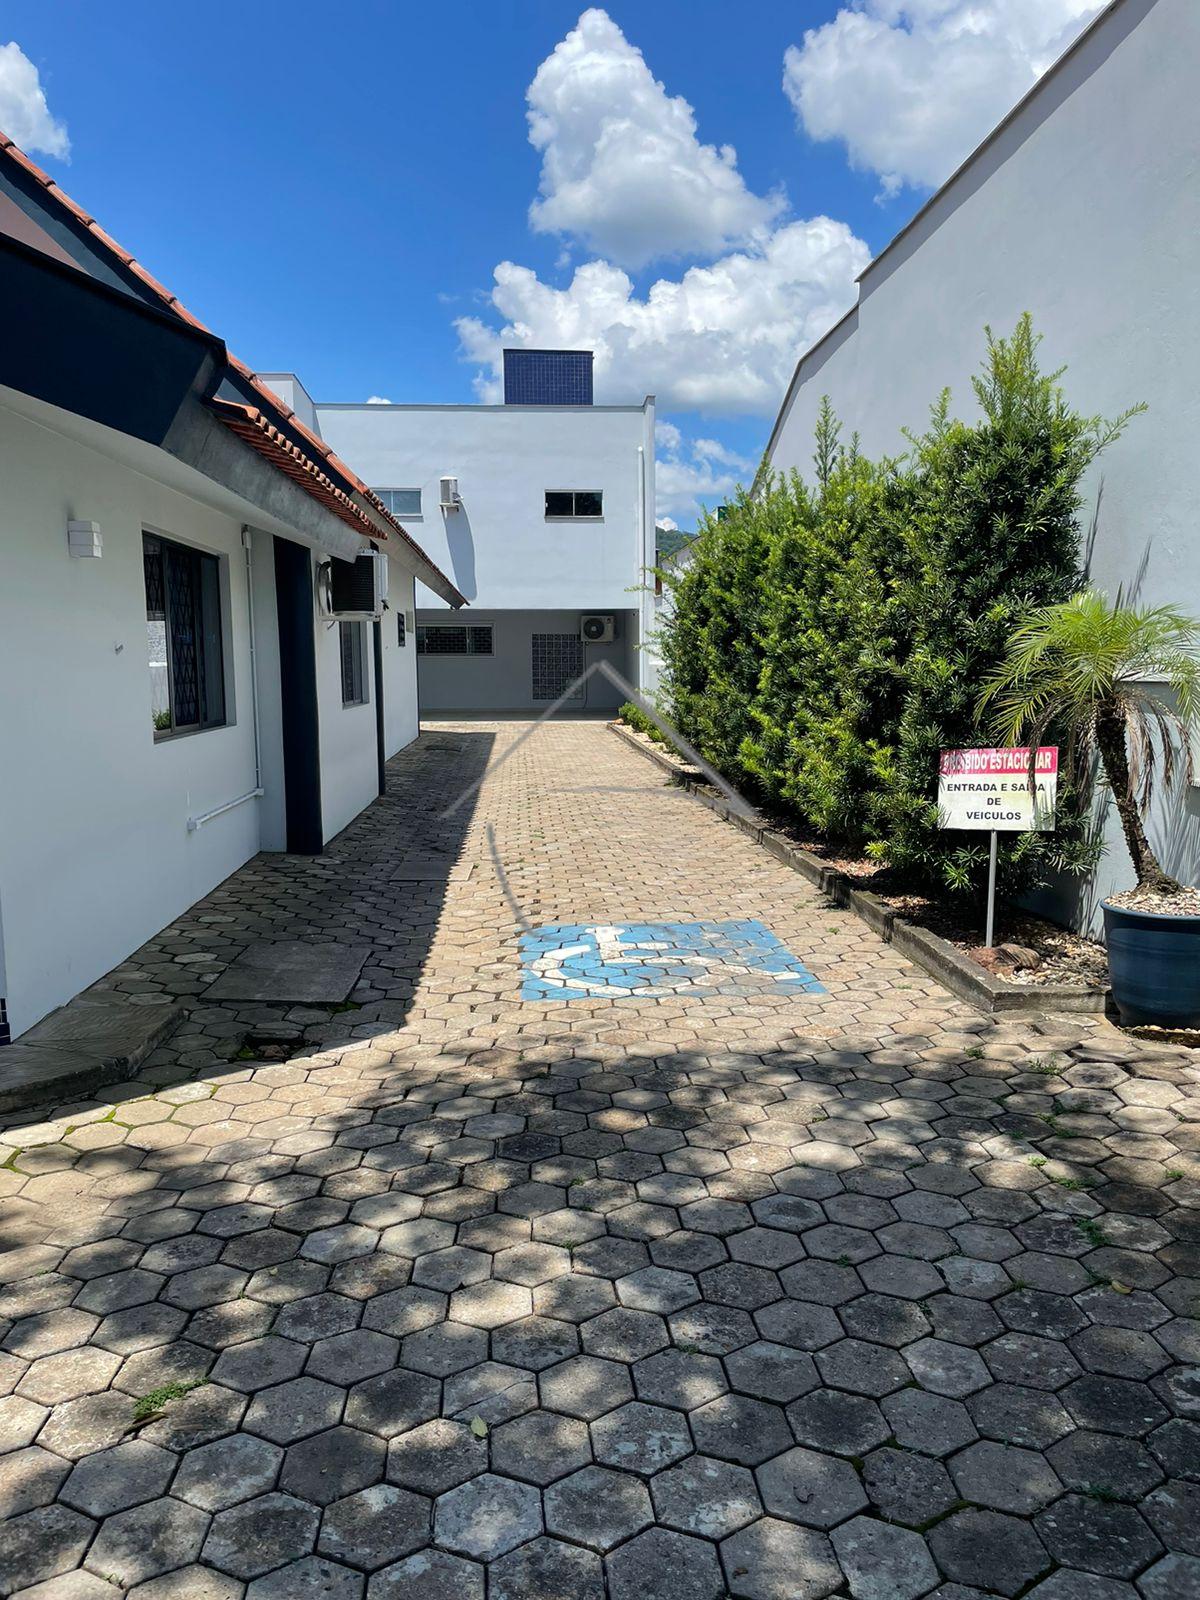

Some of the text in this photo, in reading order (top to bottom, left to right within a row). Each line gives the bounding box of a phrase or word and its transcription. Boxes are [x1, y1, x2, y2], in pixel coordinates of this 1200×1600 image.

[947, 783, 1045, 792] ENTRADA E SAIA
[987, 797, 1001, 806] DE
[966, 811, 1021, 820] VEICULOS
